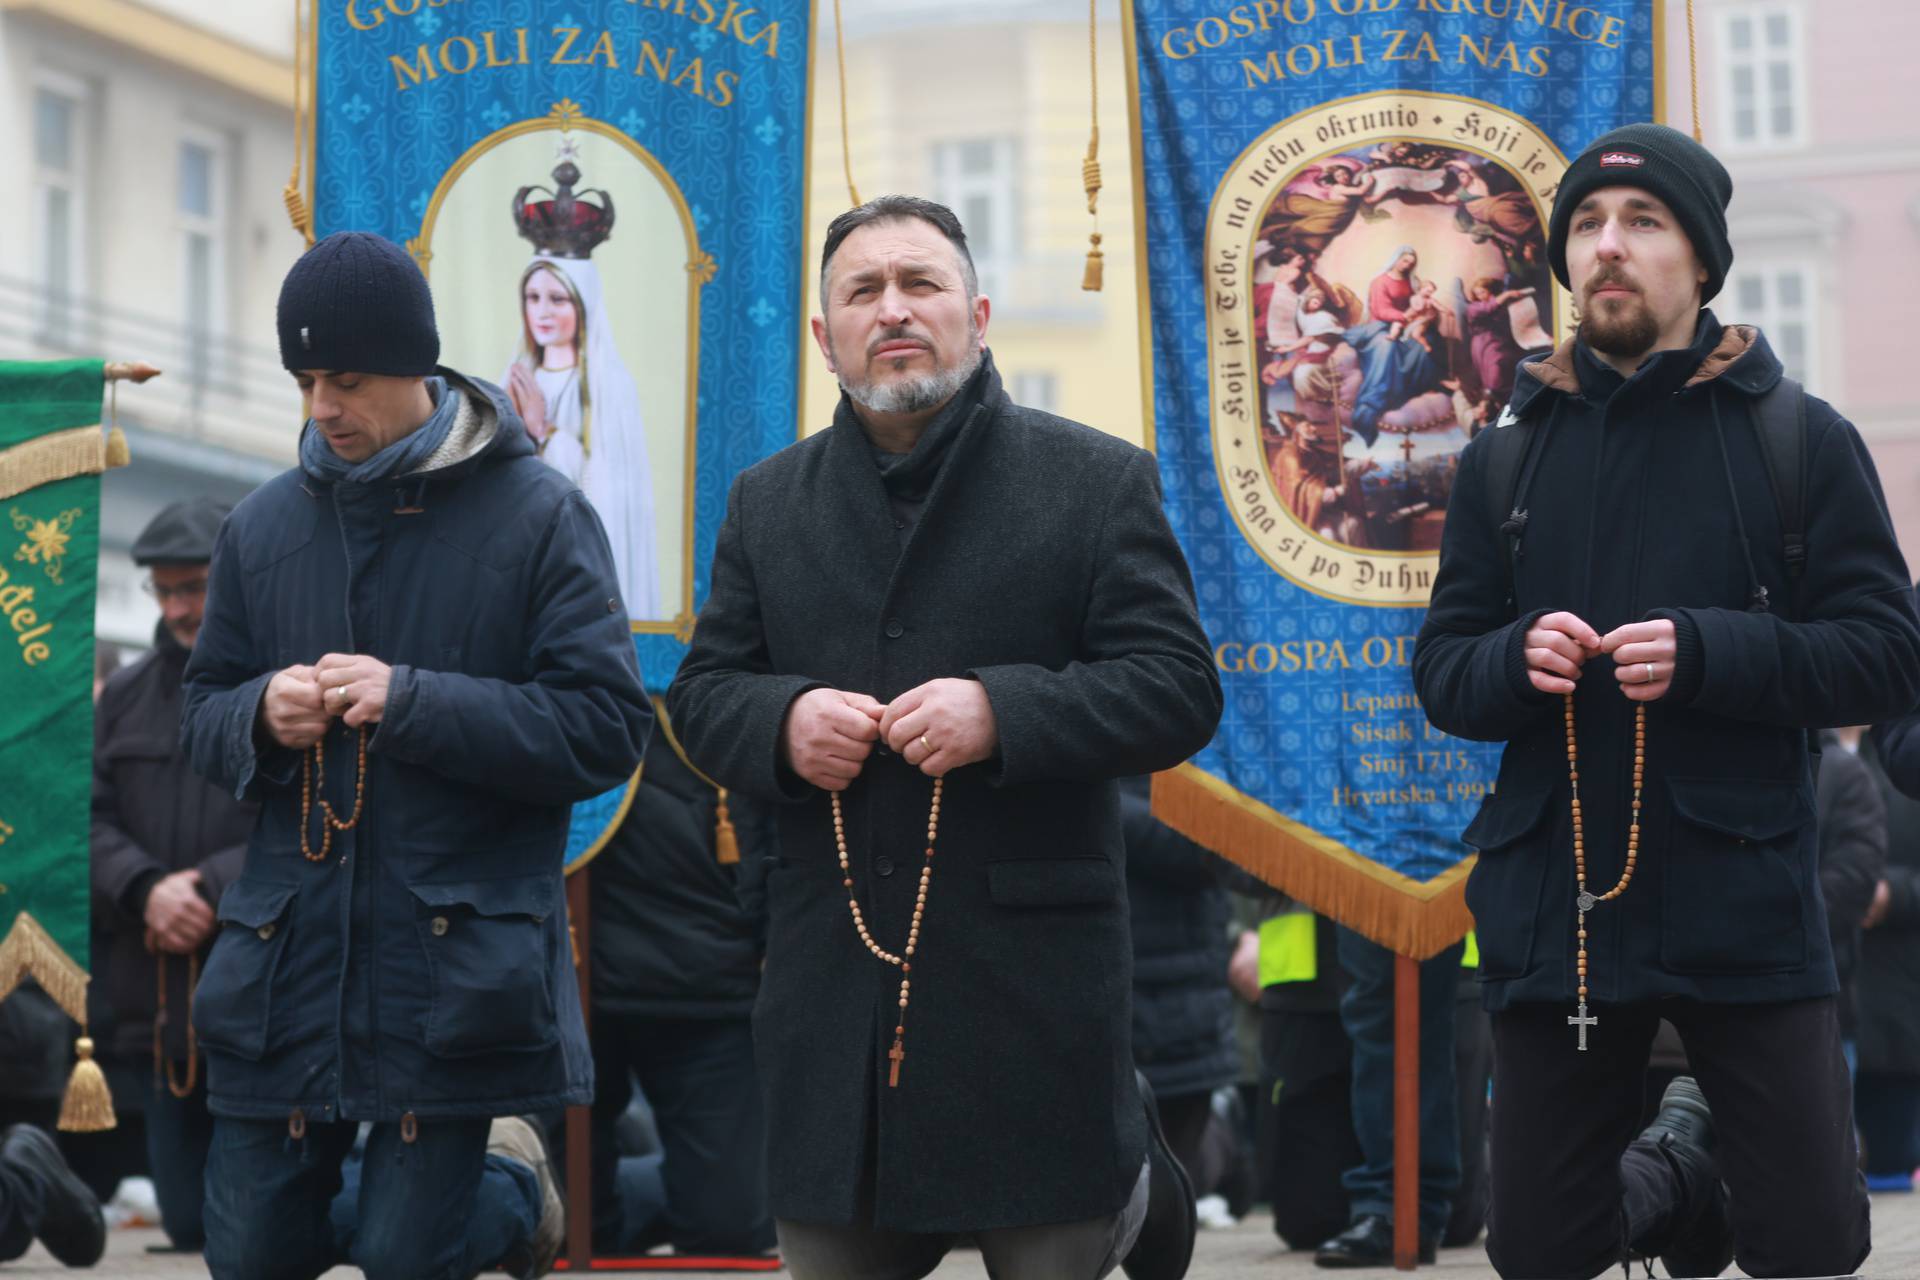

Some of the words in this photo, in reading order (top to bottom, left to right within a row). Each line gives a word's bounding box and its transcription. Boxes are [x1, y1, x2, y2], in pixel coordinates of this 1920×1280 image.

[1161, 0, 1316, 60] GOSPO
[388, 28, 531, 91] MOLI
[550, 27, 619, 68] ZA
[634, 40, 740, 107] NAS
[1239, 35, 1365, 89] MOLI
[1381, 29, 1441, 62] ZA
[1457, 34, 1550, 78] NAS
[1316, 104, 1418, 142] okrunio
[1452, 112, 1522, 153] Koji
[1521, 148, 1546, 175] je
[1249, 138, 1305, 187] nebu
[1226, 196, 1253, 229] na
[1219, 327, 1245, 347] je
[1221, 361, 1249, 423] Koji
[1278, 537, 1307, 561] si
[1309, 555, 1341, 579] po
[1352, 560, 1430, 593] Duhu
[0, 563, 52, 667] đele
[1214, 639, 1350, 673] GOSPA
[1351, 720, 1412, 744] Sisak
[1360, 751, 1406, 778] Sinj
[1332, 783, 1436, 807] Hrvatska
